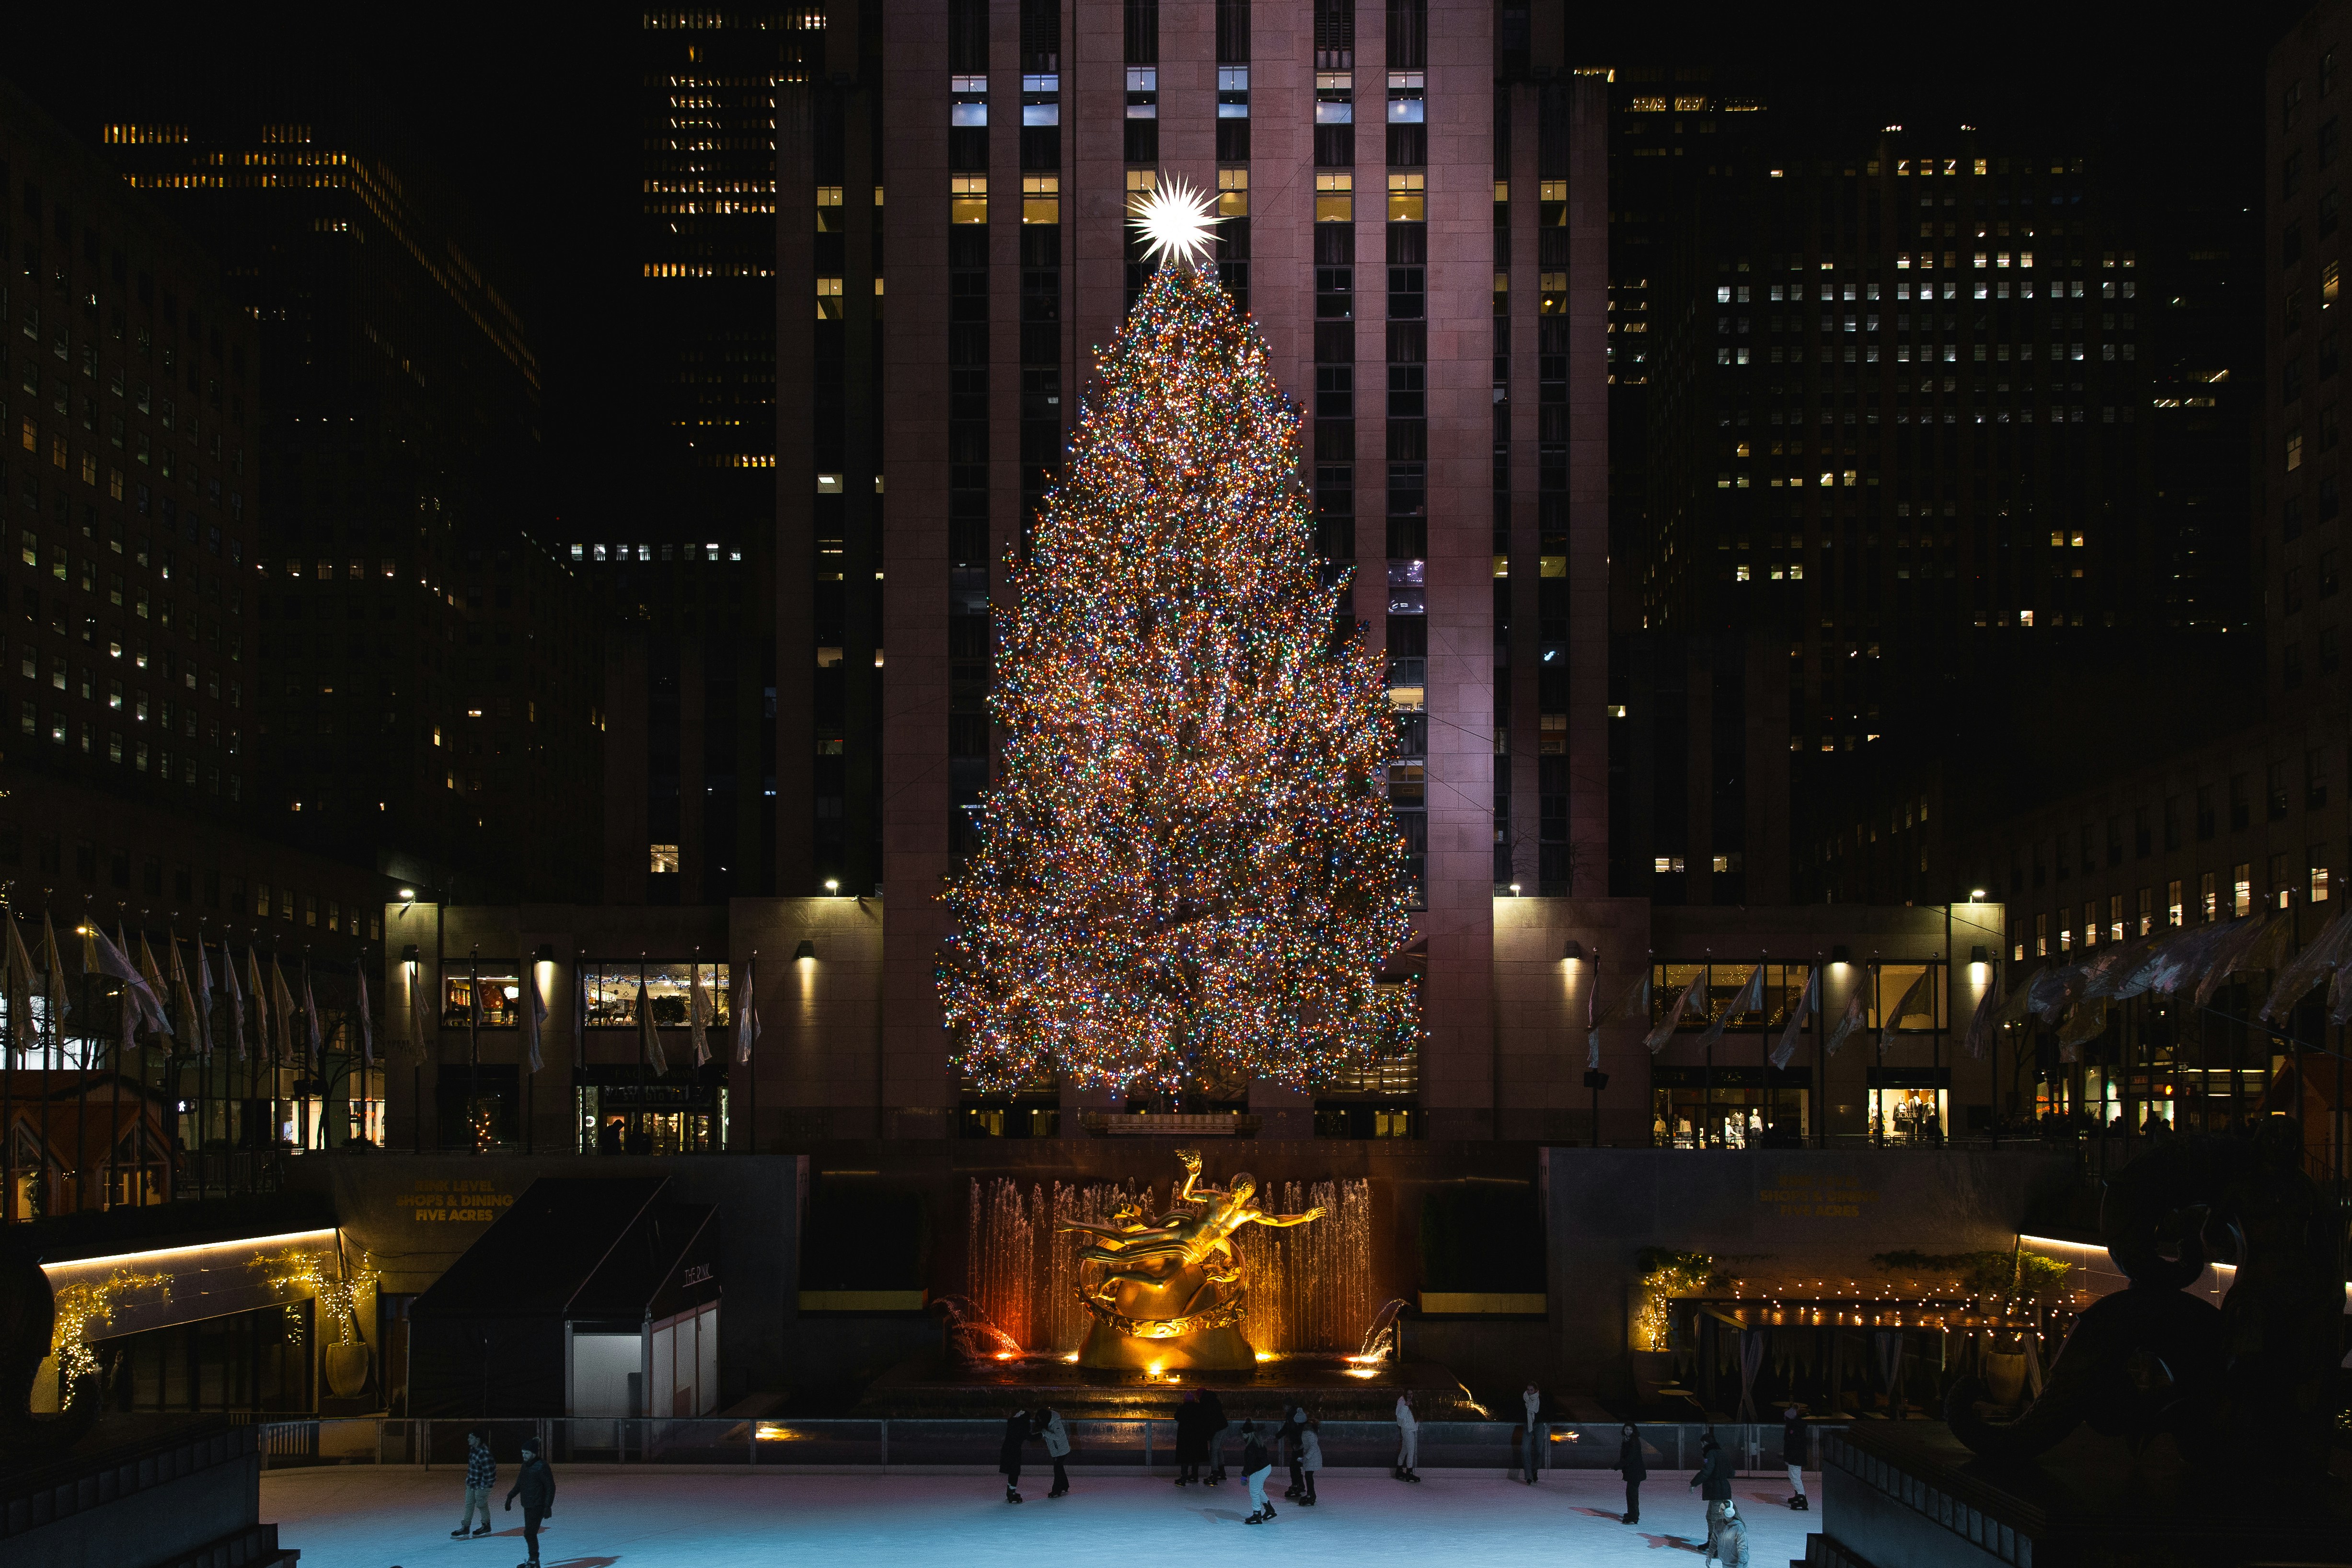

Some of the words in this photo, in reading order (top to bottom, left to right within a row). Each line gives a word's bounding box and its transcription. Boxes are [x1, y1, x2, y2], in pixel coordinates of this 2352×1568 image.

[623, 1092, 665, 1101] STDIO
[453, 1180, 495, 1192] LEVEL
[396, 1195, 444, 1206] SHOPS
[446, 1195, 459, 1206] &
[461, 1195, 514, 1206] DINING
[415, 1209, 446, 1221] FIVE
[449, 1209, 493, 1221] ACRES
[684, 1268, 695, 1285] THE
